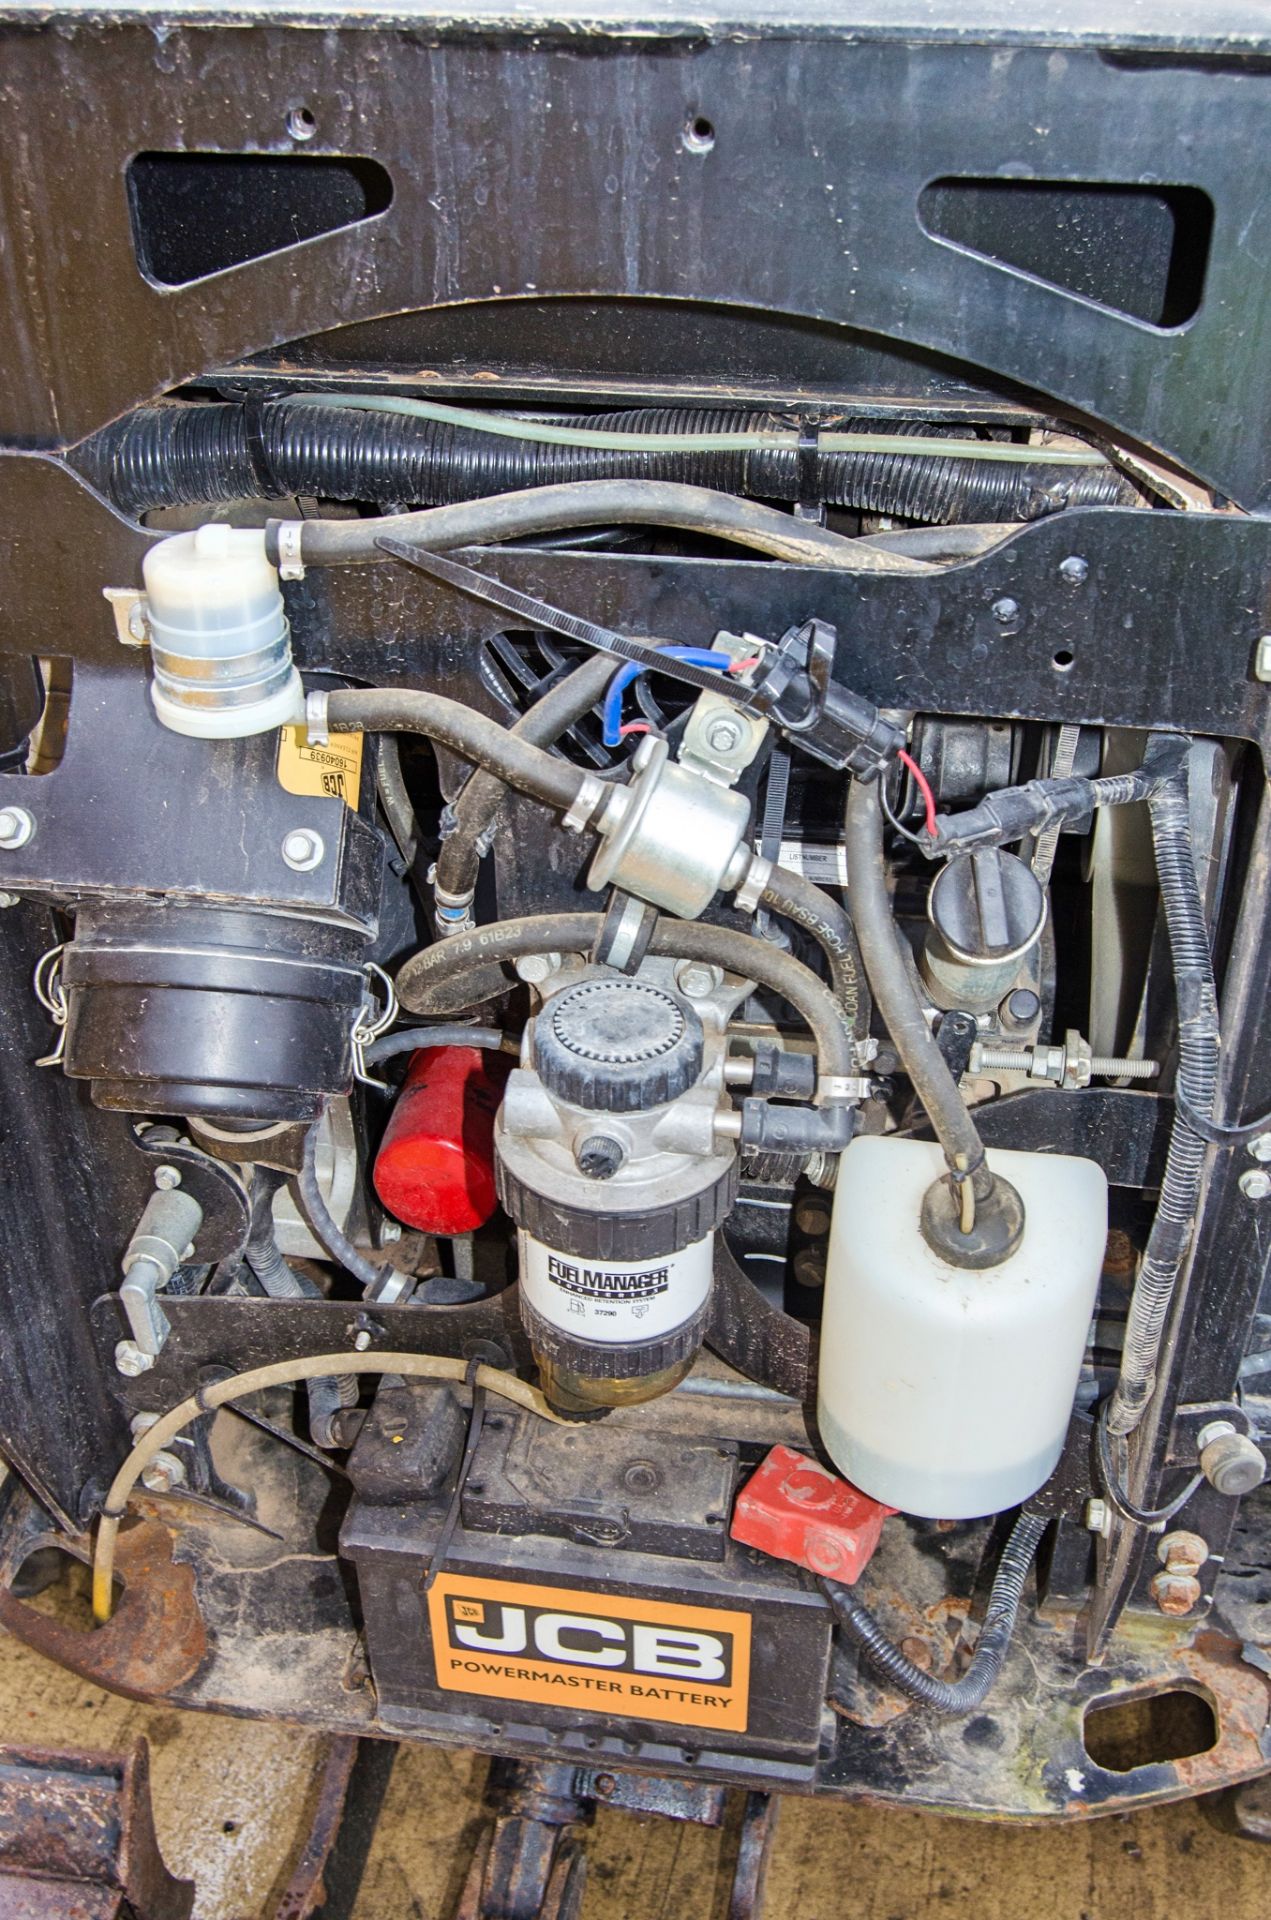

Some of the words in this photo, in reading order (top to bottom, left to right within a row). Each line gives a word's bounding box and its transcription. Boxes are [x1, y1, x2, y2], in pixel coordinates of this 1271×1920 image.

[310, 751, 347, 769] 16040939
[322, 773, 345, 799] JCB
[802, 854, 828, 862] NUMBER
[783, 898, 820, 926] BSAU
[480, 926, 521, 945] 61B23
[816, 921, 847, 954] HOSE
[839, 954, 858, 984] FUEL
[632, 1295, 656, 1304] SYSTEM
[455, 1606, 726, 1681] JCB
[450, 1659, 623, 1694] POWERMASTER
[630, 1685, 733, 1708] BATTERY
